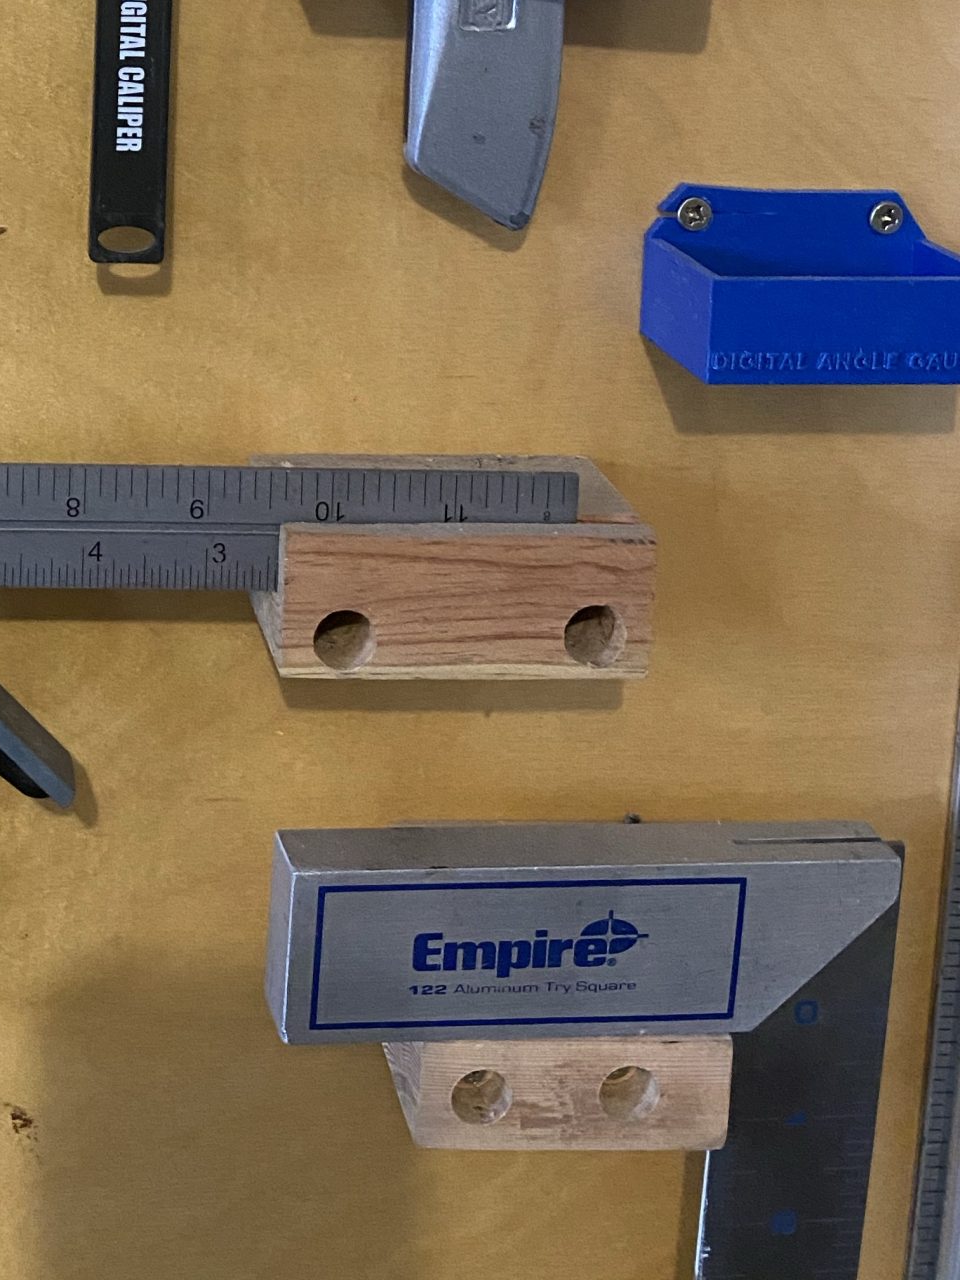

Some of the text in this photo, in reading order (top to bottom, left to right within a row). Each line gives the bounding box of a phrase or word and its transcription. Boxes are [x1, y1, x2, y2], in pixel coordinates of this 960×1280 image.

[115, 67, 145, 152] CALIPER
[712, 351, 807, 370] DIGITAL
[816, 349, 898, 370] ANGLE
[66, 497, 81, 519] 8
[315, 501, 345, 522] 10
[87, 541, 103, 562] 4
[211, 542, 227, 564] 3
[412, 929, 607, 978] Empire
[408, 980, 637, 995] 122 Aluminum Try Square
